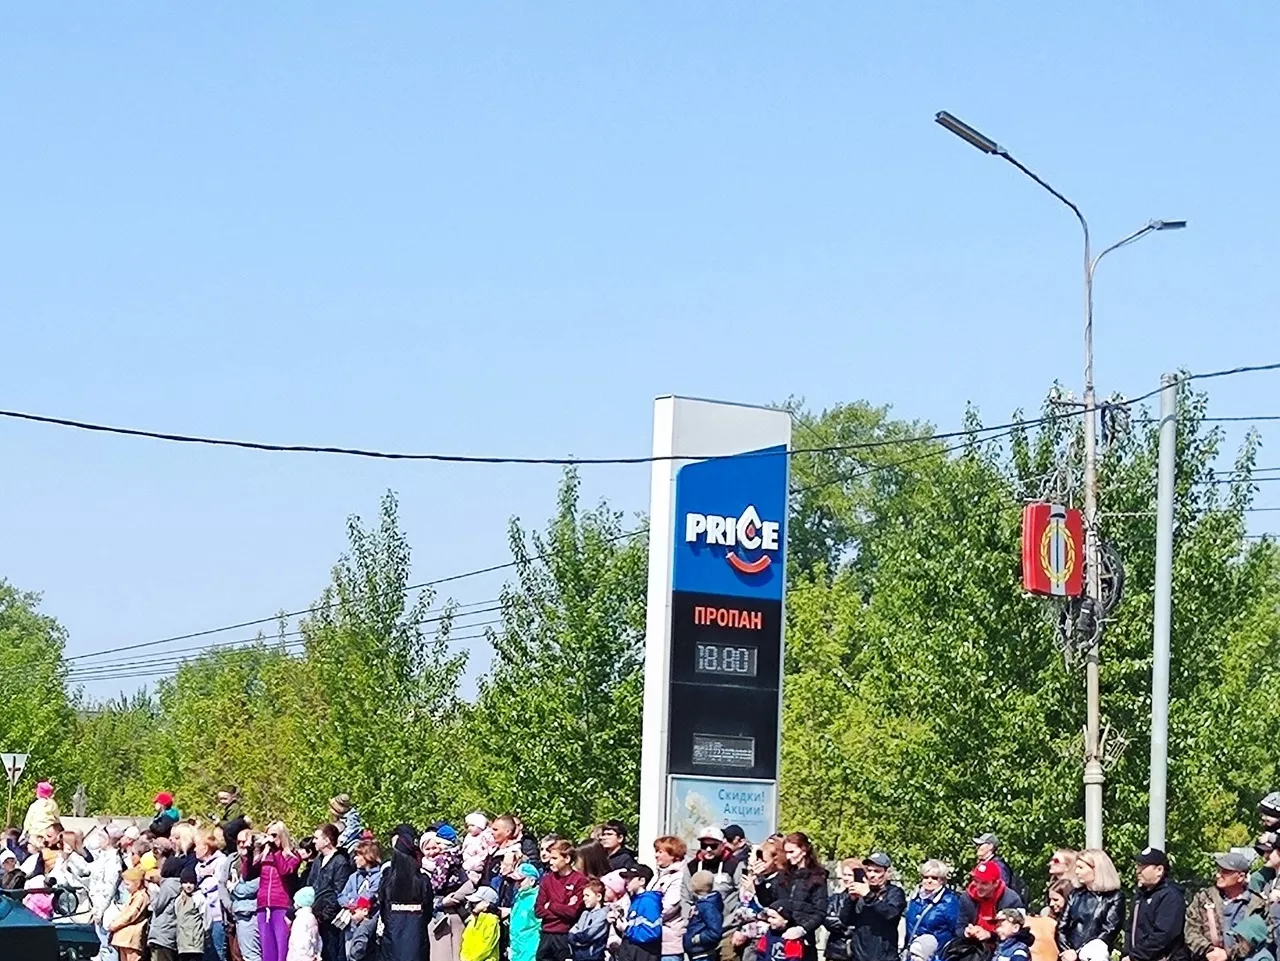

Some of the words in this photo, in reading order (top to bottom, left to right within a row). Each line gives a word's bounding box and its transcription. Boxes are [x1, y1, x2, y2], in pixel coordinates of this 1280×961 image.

[685, 505, 780, 550] PRICE
[694, 606, 762, 630] ПРОПАН
[718, 788, 765, 803] Скидки!
[723, 803, 764, 817] Акции!
